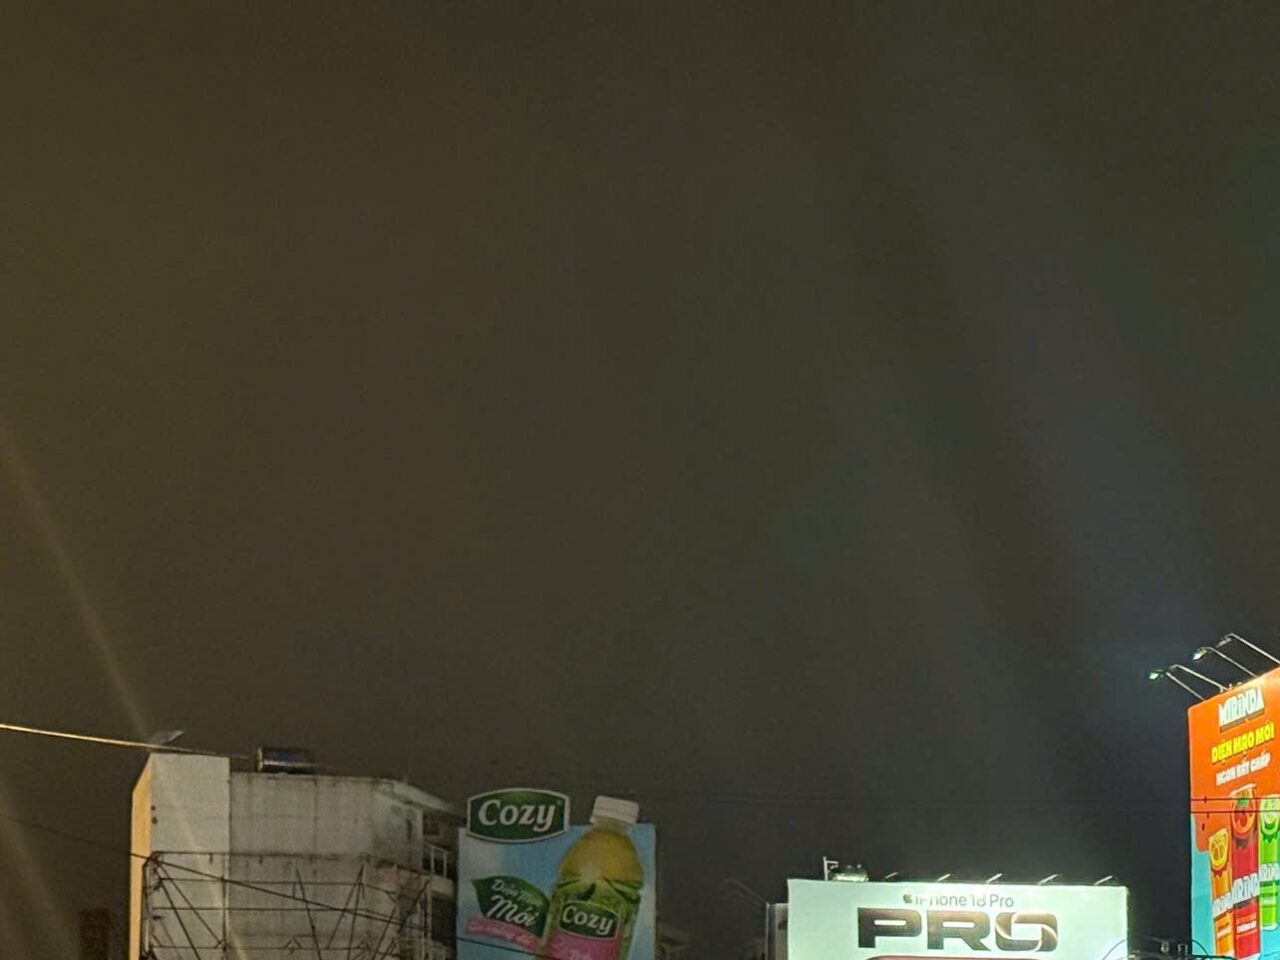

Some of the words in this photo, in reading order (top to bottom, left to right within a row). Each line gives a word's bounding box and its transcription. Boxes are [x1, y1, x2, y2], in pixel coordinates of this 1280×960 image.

[478, 799, 556, 832] Cozy
[989, 894, 1014, 908] Pro
[563, 906, 613, 935] Cozy
[857, 907, 1058, 952] PRO
